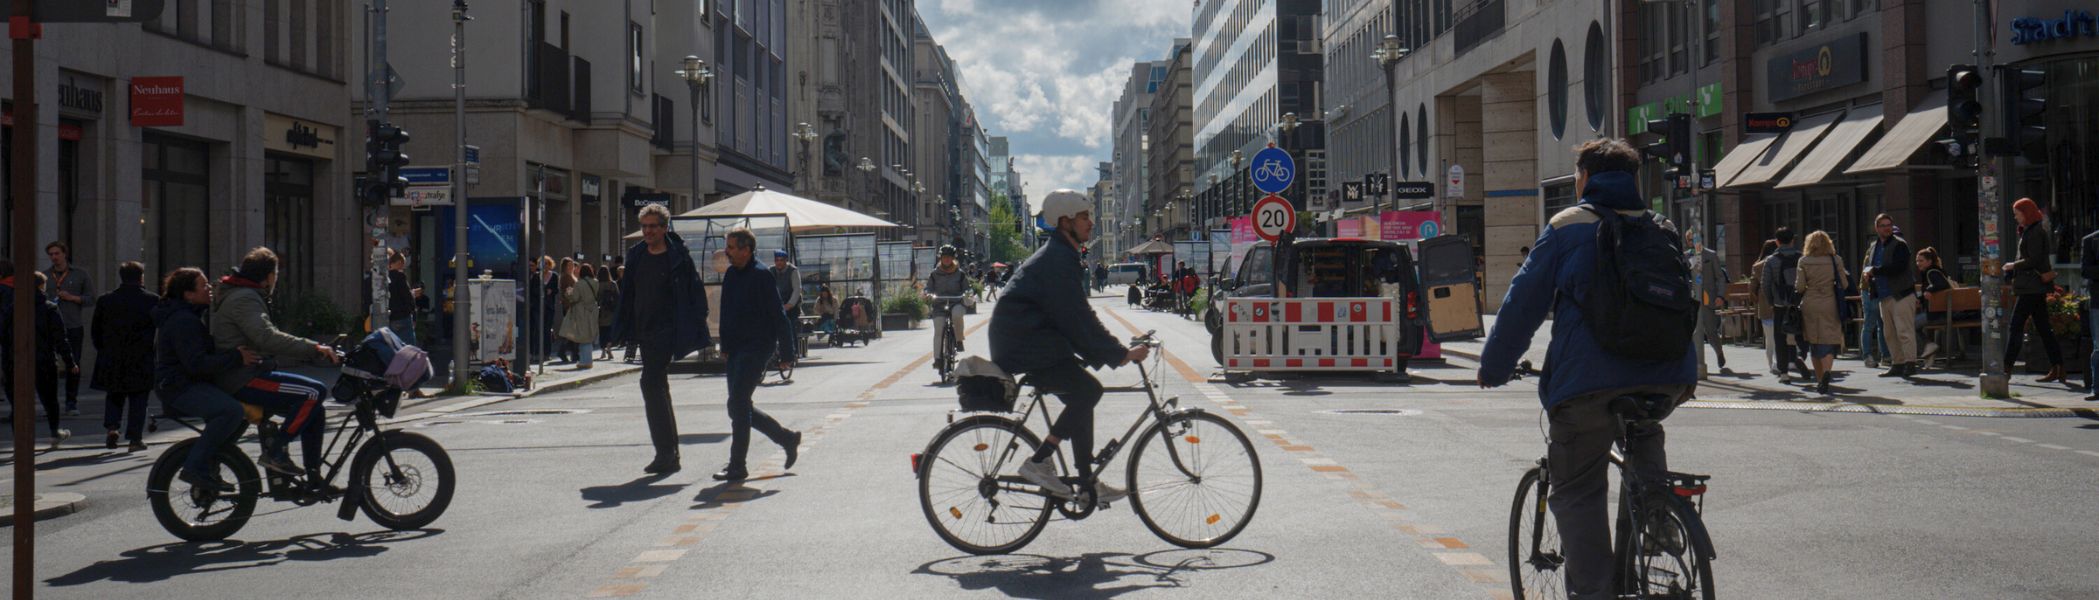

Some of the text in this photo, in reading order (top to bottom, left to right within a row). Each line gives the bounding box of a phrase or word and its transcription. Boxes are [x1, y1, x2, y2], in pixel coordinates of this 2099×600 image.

[2010, 8, 2099, 45] Stadt
[133, 84, 181, 95] Neuhaus
[1262, 209, 1285, 228] 20
